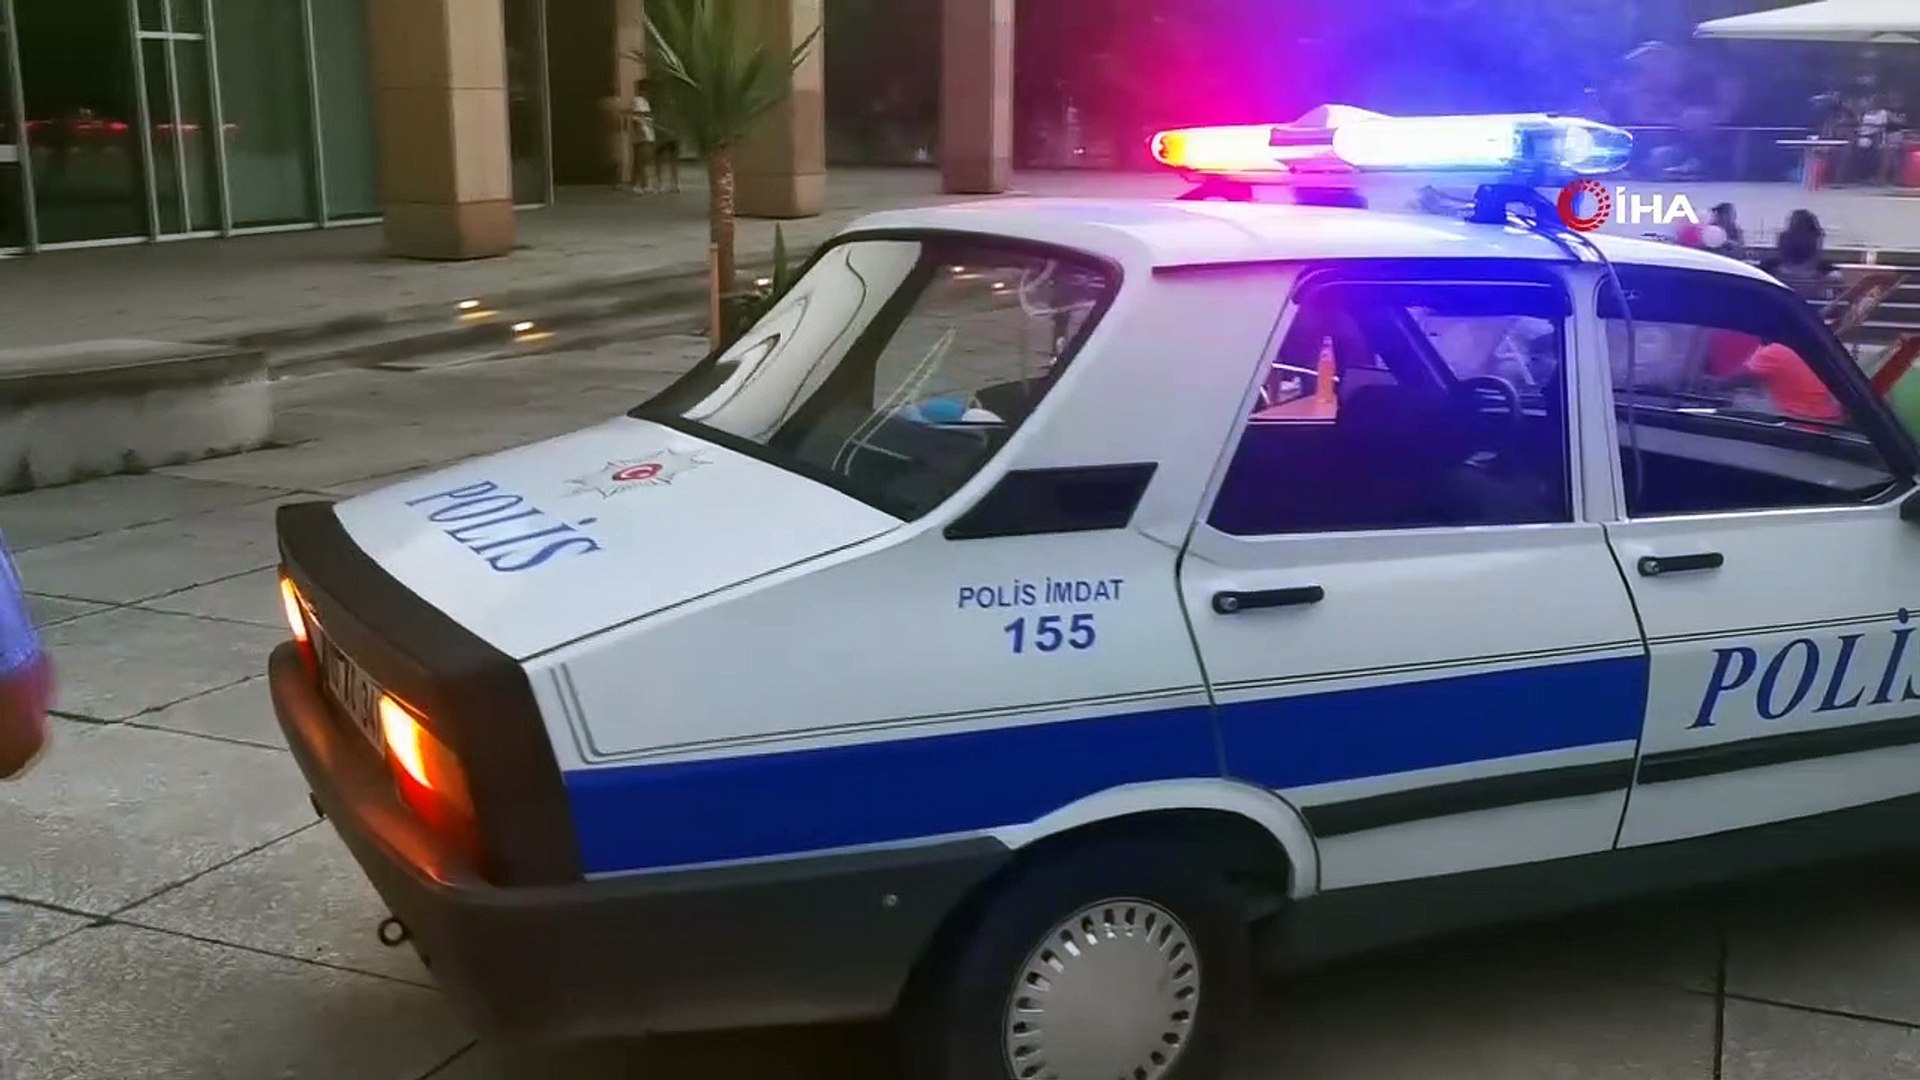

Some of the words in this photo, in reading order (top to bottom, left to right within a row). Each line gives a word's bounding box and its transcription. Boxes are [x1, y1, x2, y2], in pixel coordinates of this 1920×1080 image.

[405, 480, 603, 572] POLİS
[958, 579, 1037, 609] POLİS
[1045, 577, 1125, 604] İMDAT
[1003, 613, 1097, 654] 155
